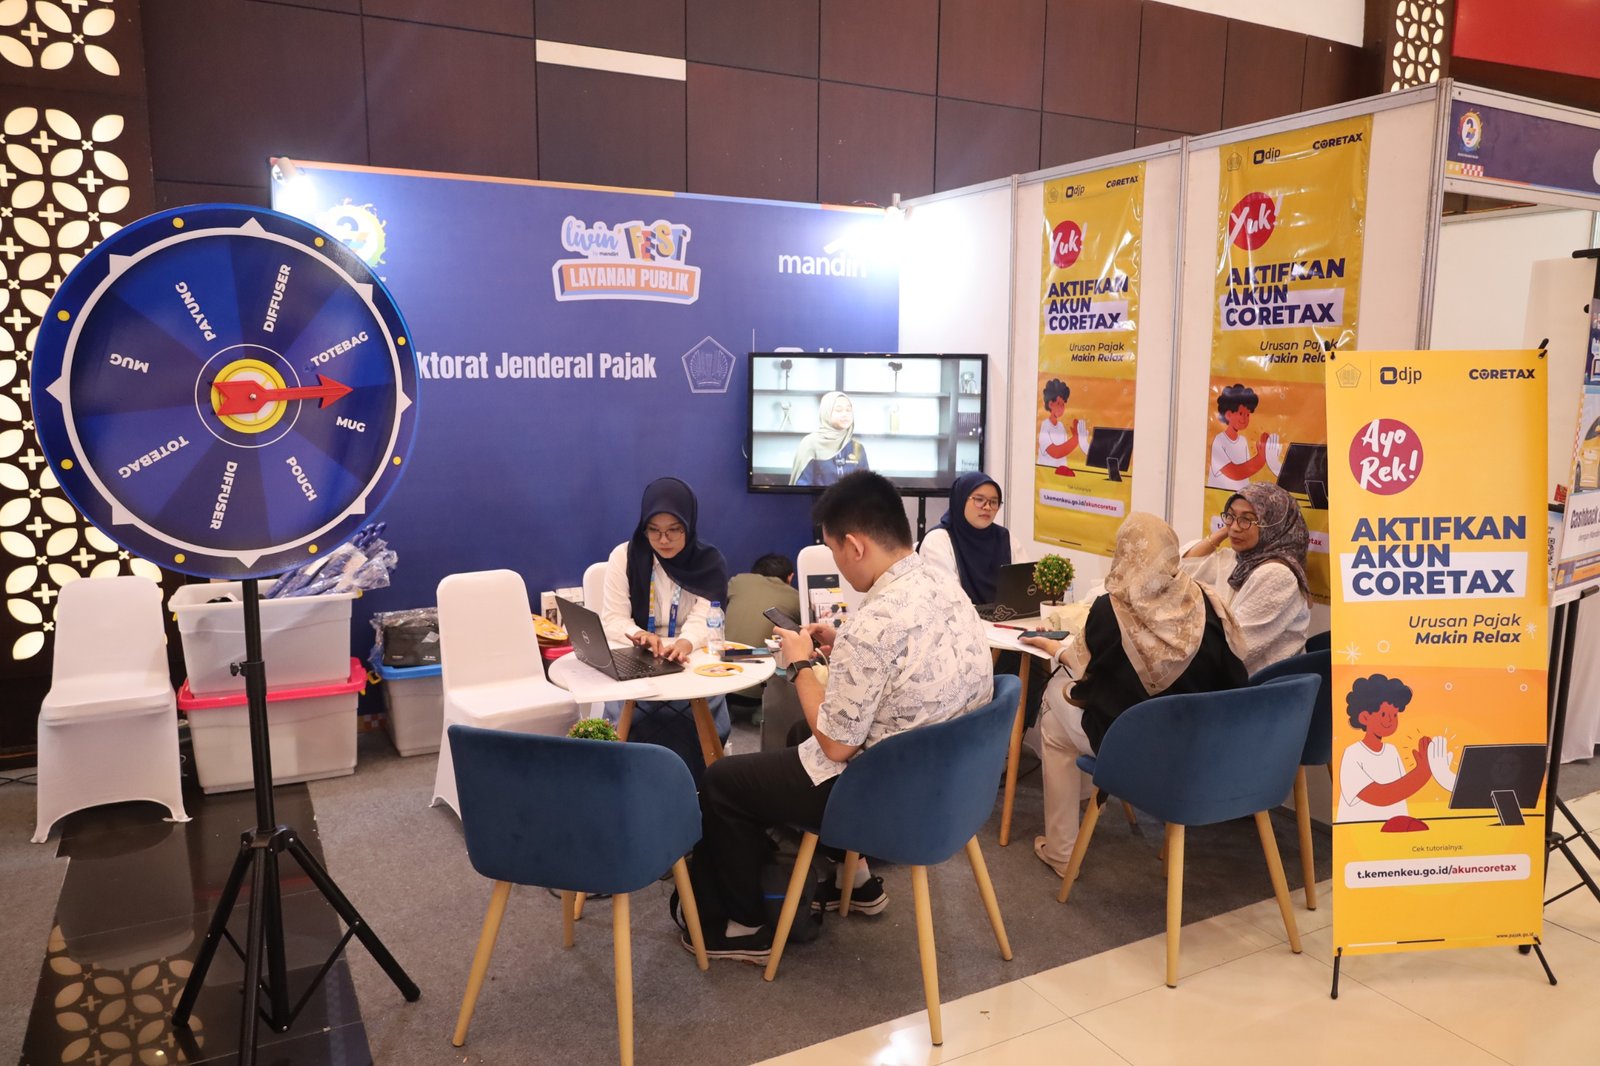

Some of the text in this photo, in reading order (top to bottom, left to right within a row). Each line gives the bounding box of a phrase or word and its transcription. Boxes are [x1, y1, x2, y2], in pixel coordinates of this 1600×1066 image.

[1313, 132, 1363, 150] CORETAX
[1265, 147, 1281, 162] djp
[1073, 184, 1085, 196] djp
[1106, 175, 1139, 188] CORETAX
[1228, 193, 1283, 246] Yuk!
[624, 224, 687, 262] FEST
[570, 267, 689, 292] LAYANAN PUBLIK
[1225, 258, 1346, 286] AKTIFKAN
[1048, 276, 1128, 298] AKTIFKAN
[1225, 284, 1288, 306] AKUN
[263, 264, 292, 333] DIFFUSER
[1048, 297, 1092, 314] AKUN
[175, 280, 217, 342] PAYUNG
[1049, 312, 1121, 331] CORETAX
[1225, 302, 1336, 326] CORETAX
[310, 330, 369, 368] TOTEBAG
[1069, 342, 1125, 353] Urusan Pajak
[1260, 338, 1338, 353] Urusan Pajk
[109, 353, 149, 373] MUG
[416, 351, 657, 381] ktorat Jenderal Pajak
[1071, 353, 1124, 362] Makin Relax
[1302, 352, 1326, 363] Rela
[1398, 366, 1422, 385] djp
[1468, 368, 1536, 380] CORETAX
[336, 416, 366, 434] MUG
[1361, 419, 1407, 458] Ayo
[118, 435, 190, 478] TOTEBAG
[285, 456, 318, 502] POUCH
[1360, 449, 1419, 490] Rek!
[209, 461, 238, 530] DIFFUSER
[1350, 515, 1526, 542] AKTIFKAN
[1351, 543, 1450, 569] AKUN
[1352, 569, 1515, 597] CORETAX
[1408, 613, 1522, 630] Urusan Pajak
[1415, 630, 1521, 645] Makin Relax
[1411, 845, 1425, 853] Cek
[1357, 862, 1517, 880] t.kemenkeu.go.id/akuncoretax
